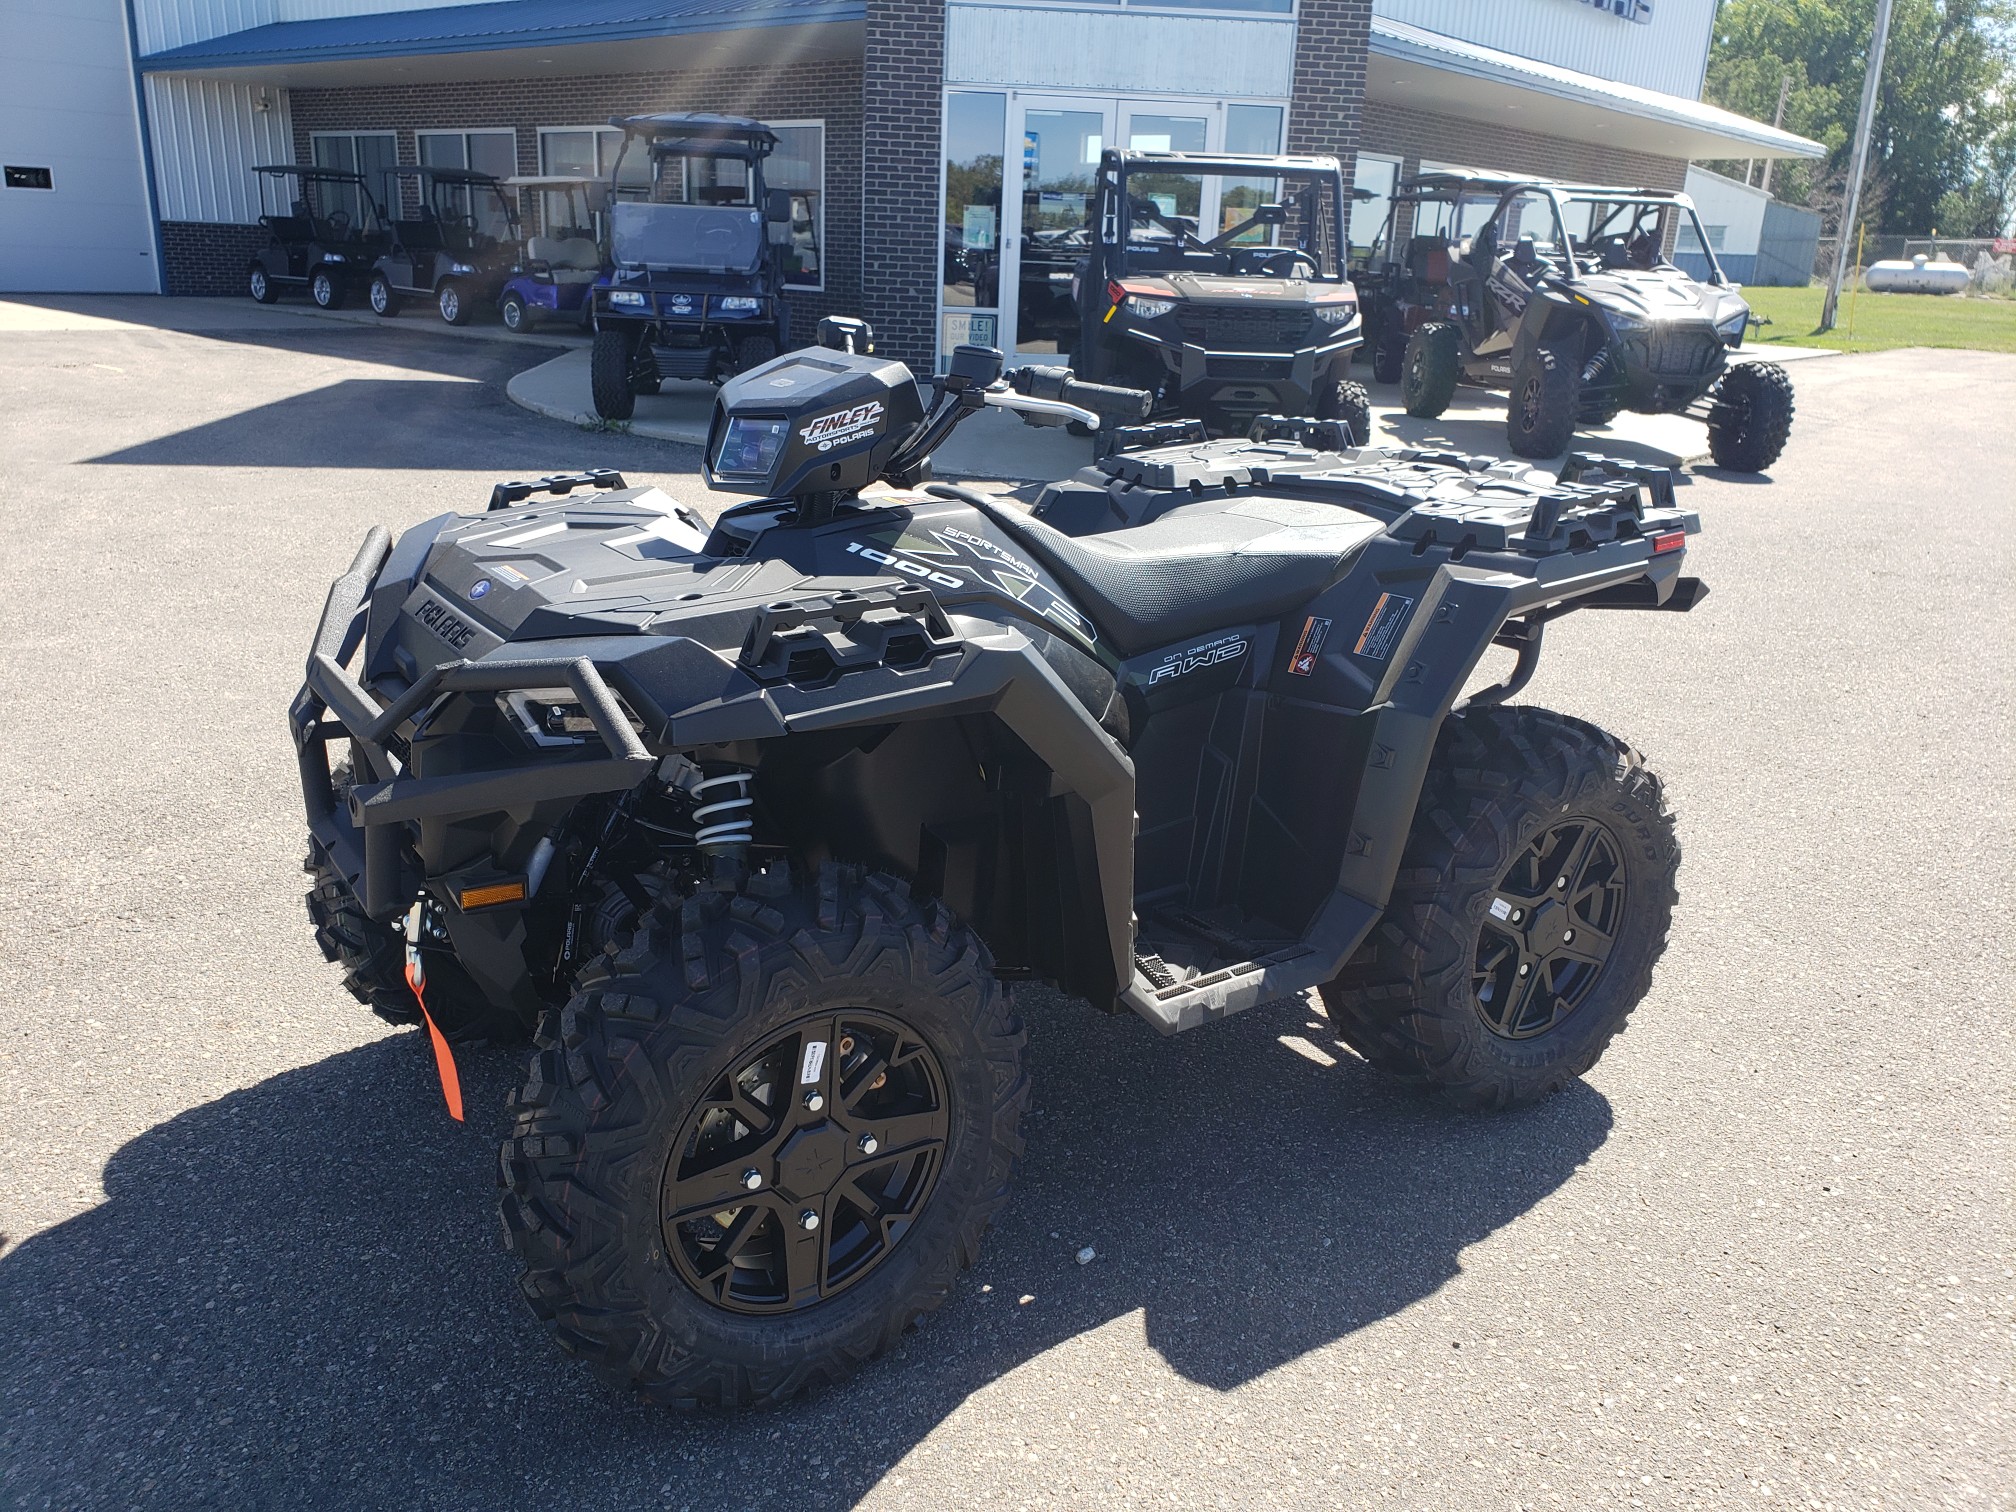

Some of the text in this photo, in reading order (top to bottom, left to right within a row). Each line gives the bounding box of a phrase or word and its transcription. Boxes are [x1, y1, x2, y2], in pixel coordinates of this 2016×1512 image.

[1486, 276, 1527, 312] RZR
[969, 333, 989, 341] VIDEO
[1491, 364, 1511, 374] POLARIS
[803, 403, 881, 438] FINLEY
[805, 424, 859, 443] MOTORSPORTS
[832, 428, 874, 447] POLARIS
[845, 541, 964, 589] 1000
[943, 525, 1039, 579] SPORTSMAN
[414, 599, 477, 651] POLARIS
[1148, 640, 1248, 685] AWD
[1163, 633, 1240, 663] ON DEMAND
